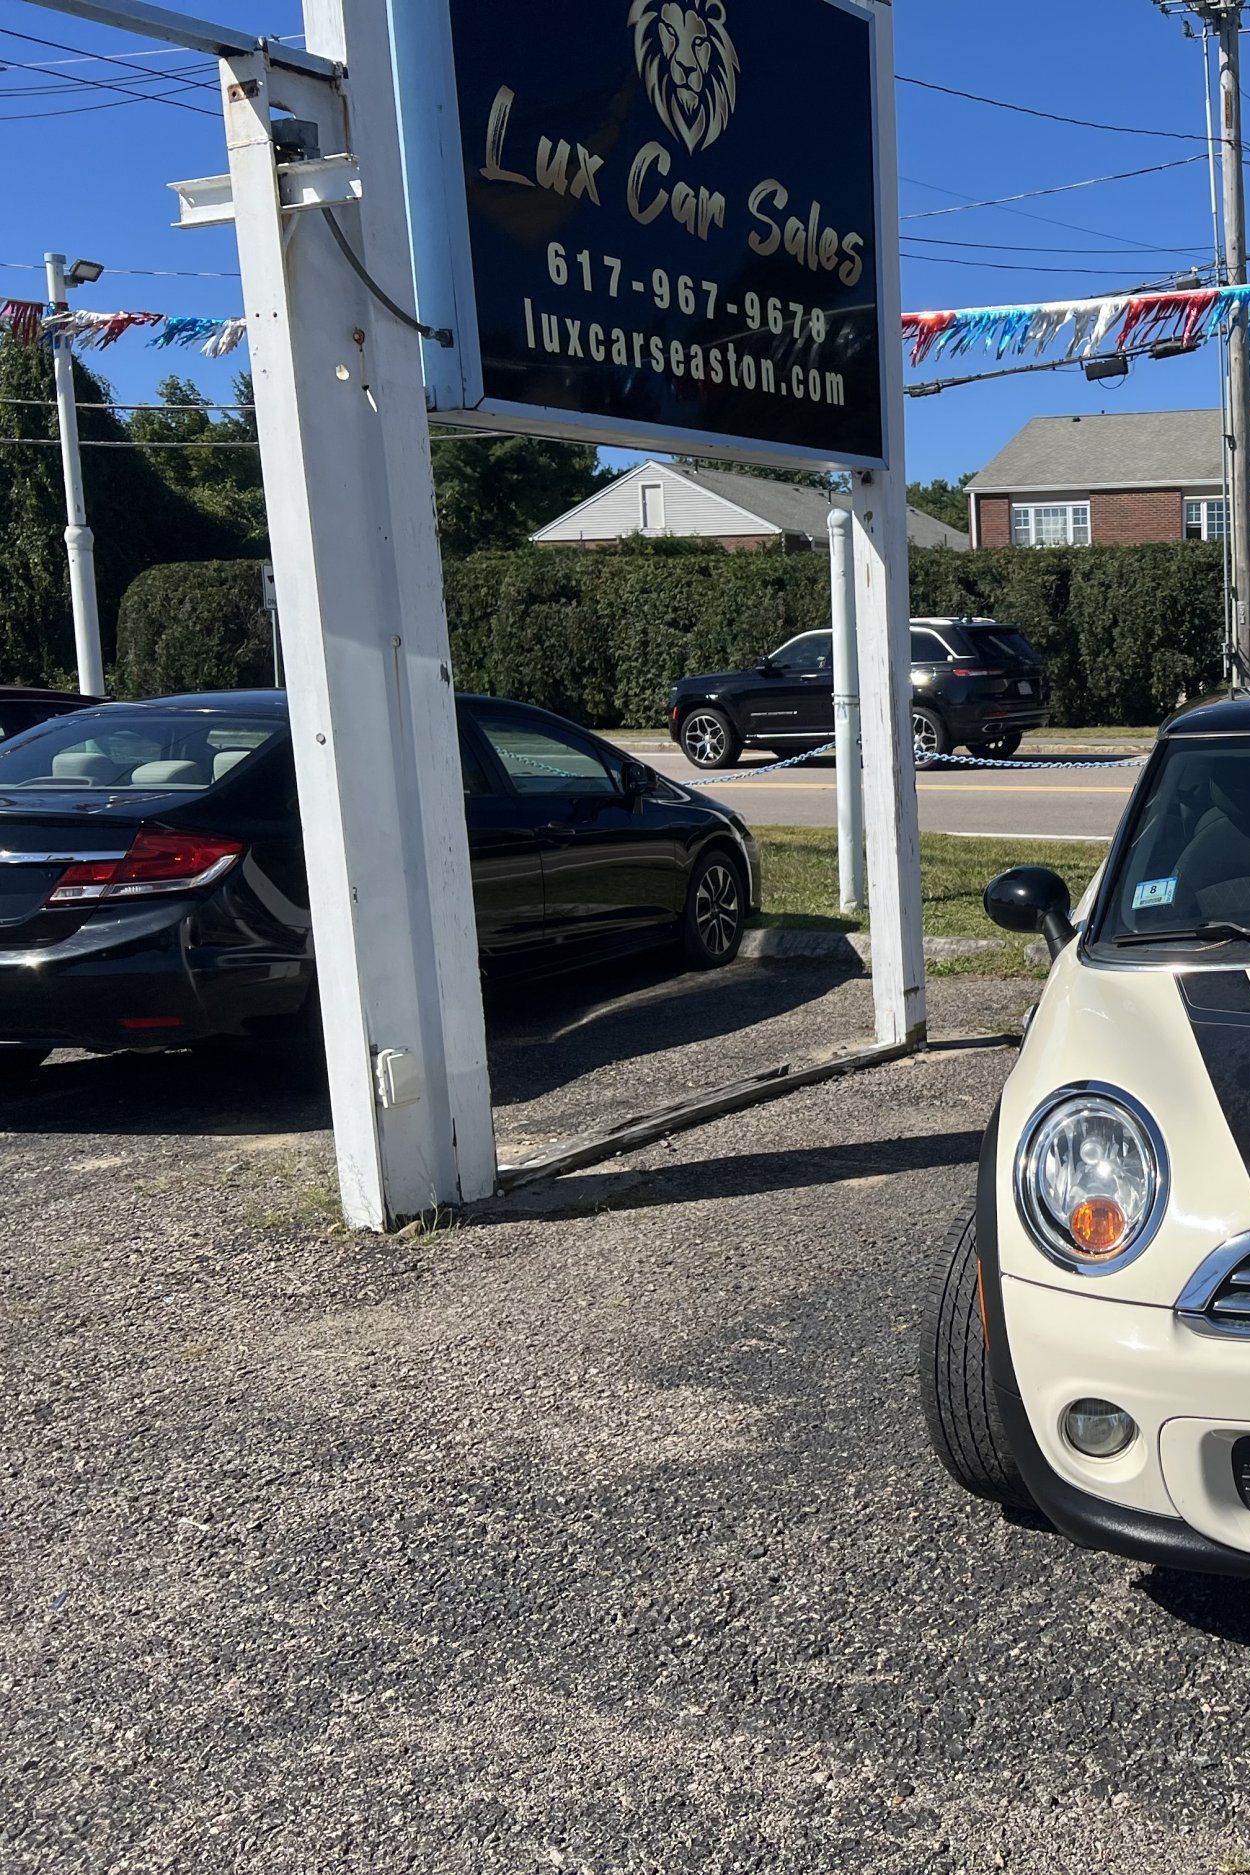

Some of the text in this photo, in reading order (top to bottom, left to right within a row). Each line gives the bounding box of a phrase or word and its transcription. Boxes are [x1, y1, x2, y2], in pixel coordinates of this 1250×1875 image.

[479, 84, 865, 288] Lux Car Sales
[547, 241, 826, 343] 617-967-9678
[523, 296, 845, 406] luxcarseaston.com
[1149, 885, 1157, 894] 8
